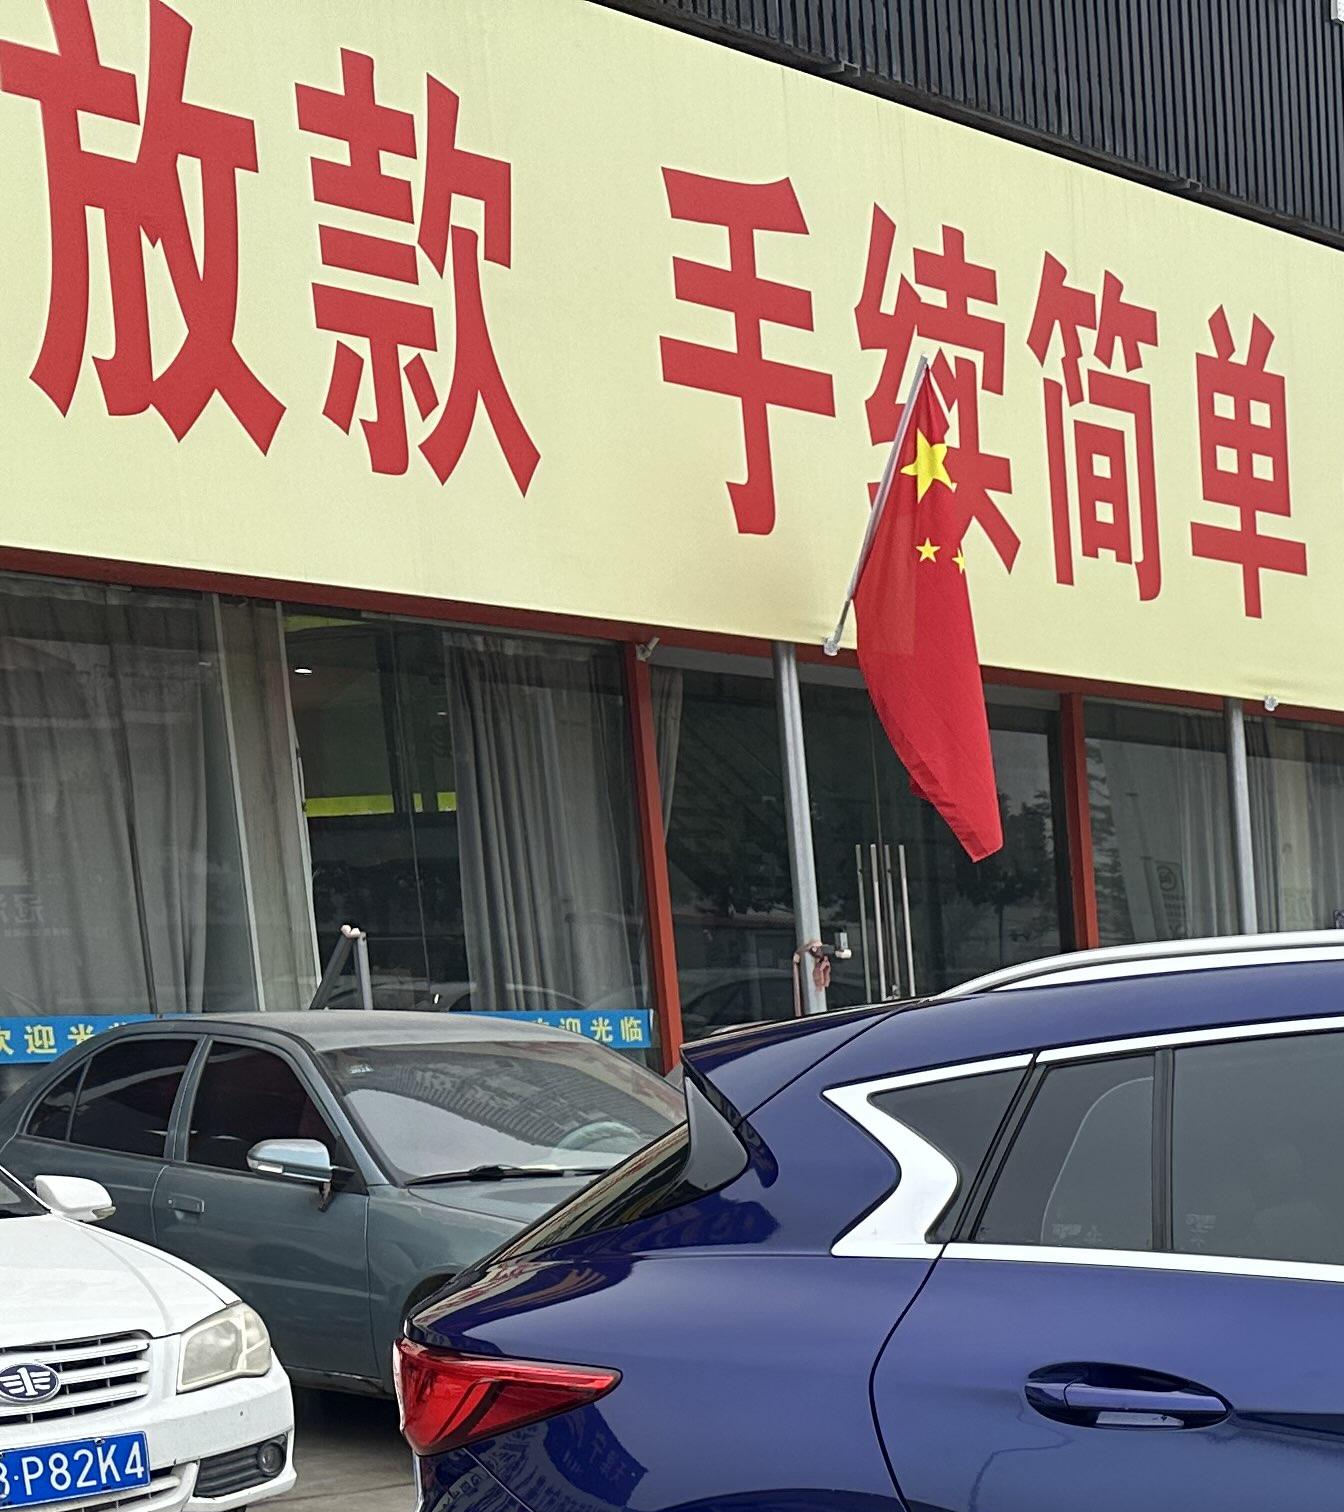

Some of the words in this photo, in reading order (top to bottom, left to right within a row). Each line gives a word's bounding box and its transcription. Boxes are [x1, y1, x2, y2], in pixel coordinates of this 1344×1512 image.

[0, 0, 541, 498] 放款
[660, 166, 1308, 620] 手续简单
